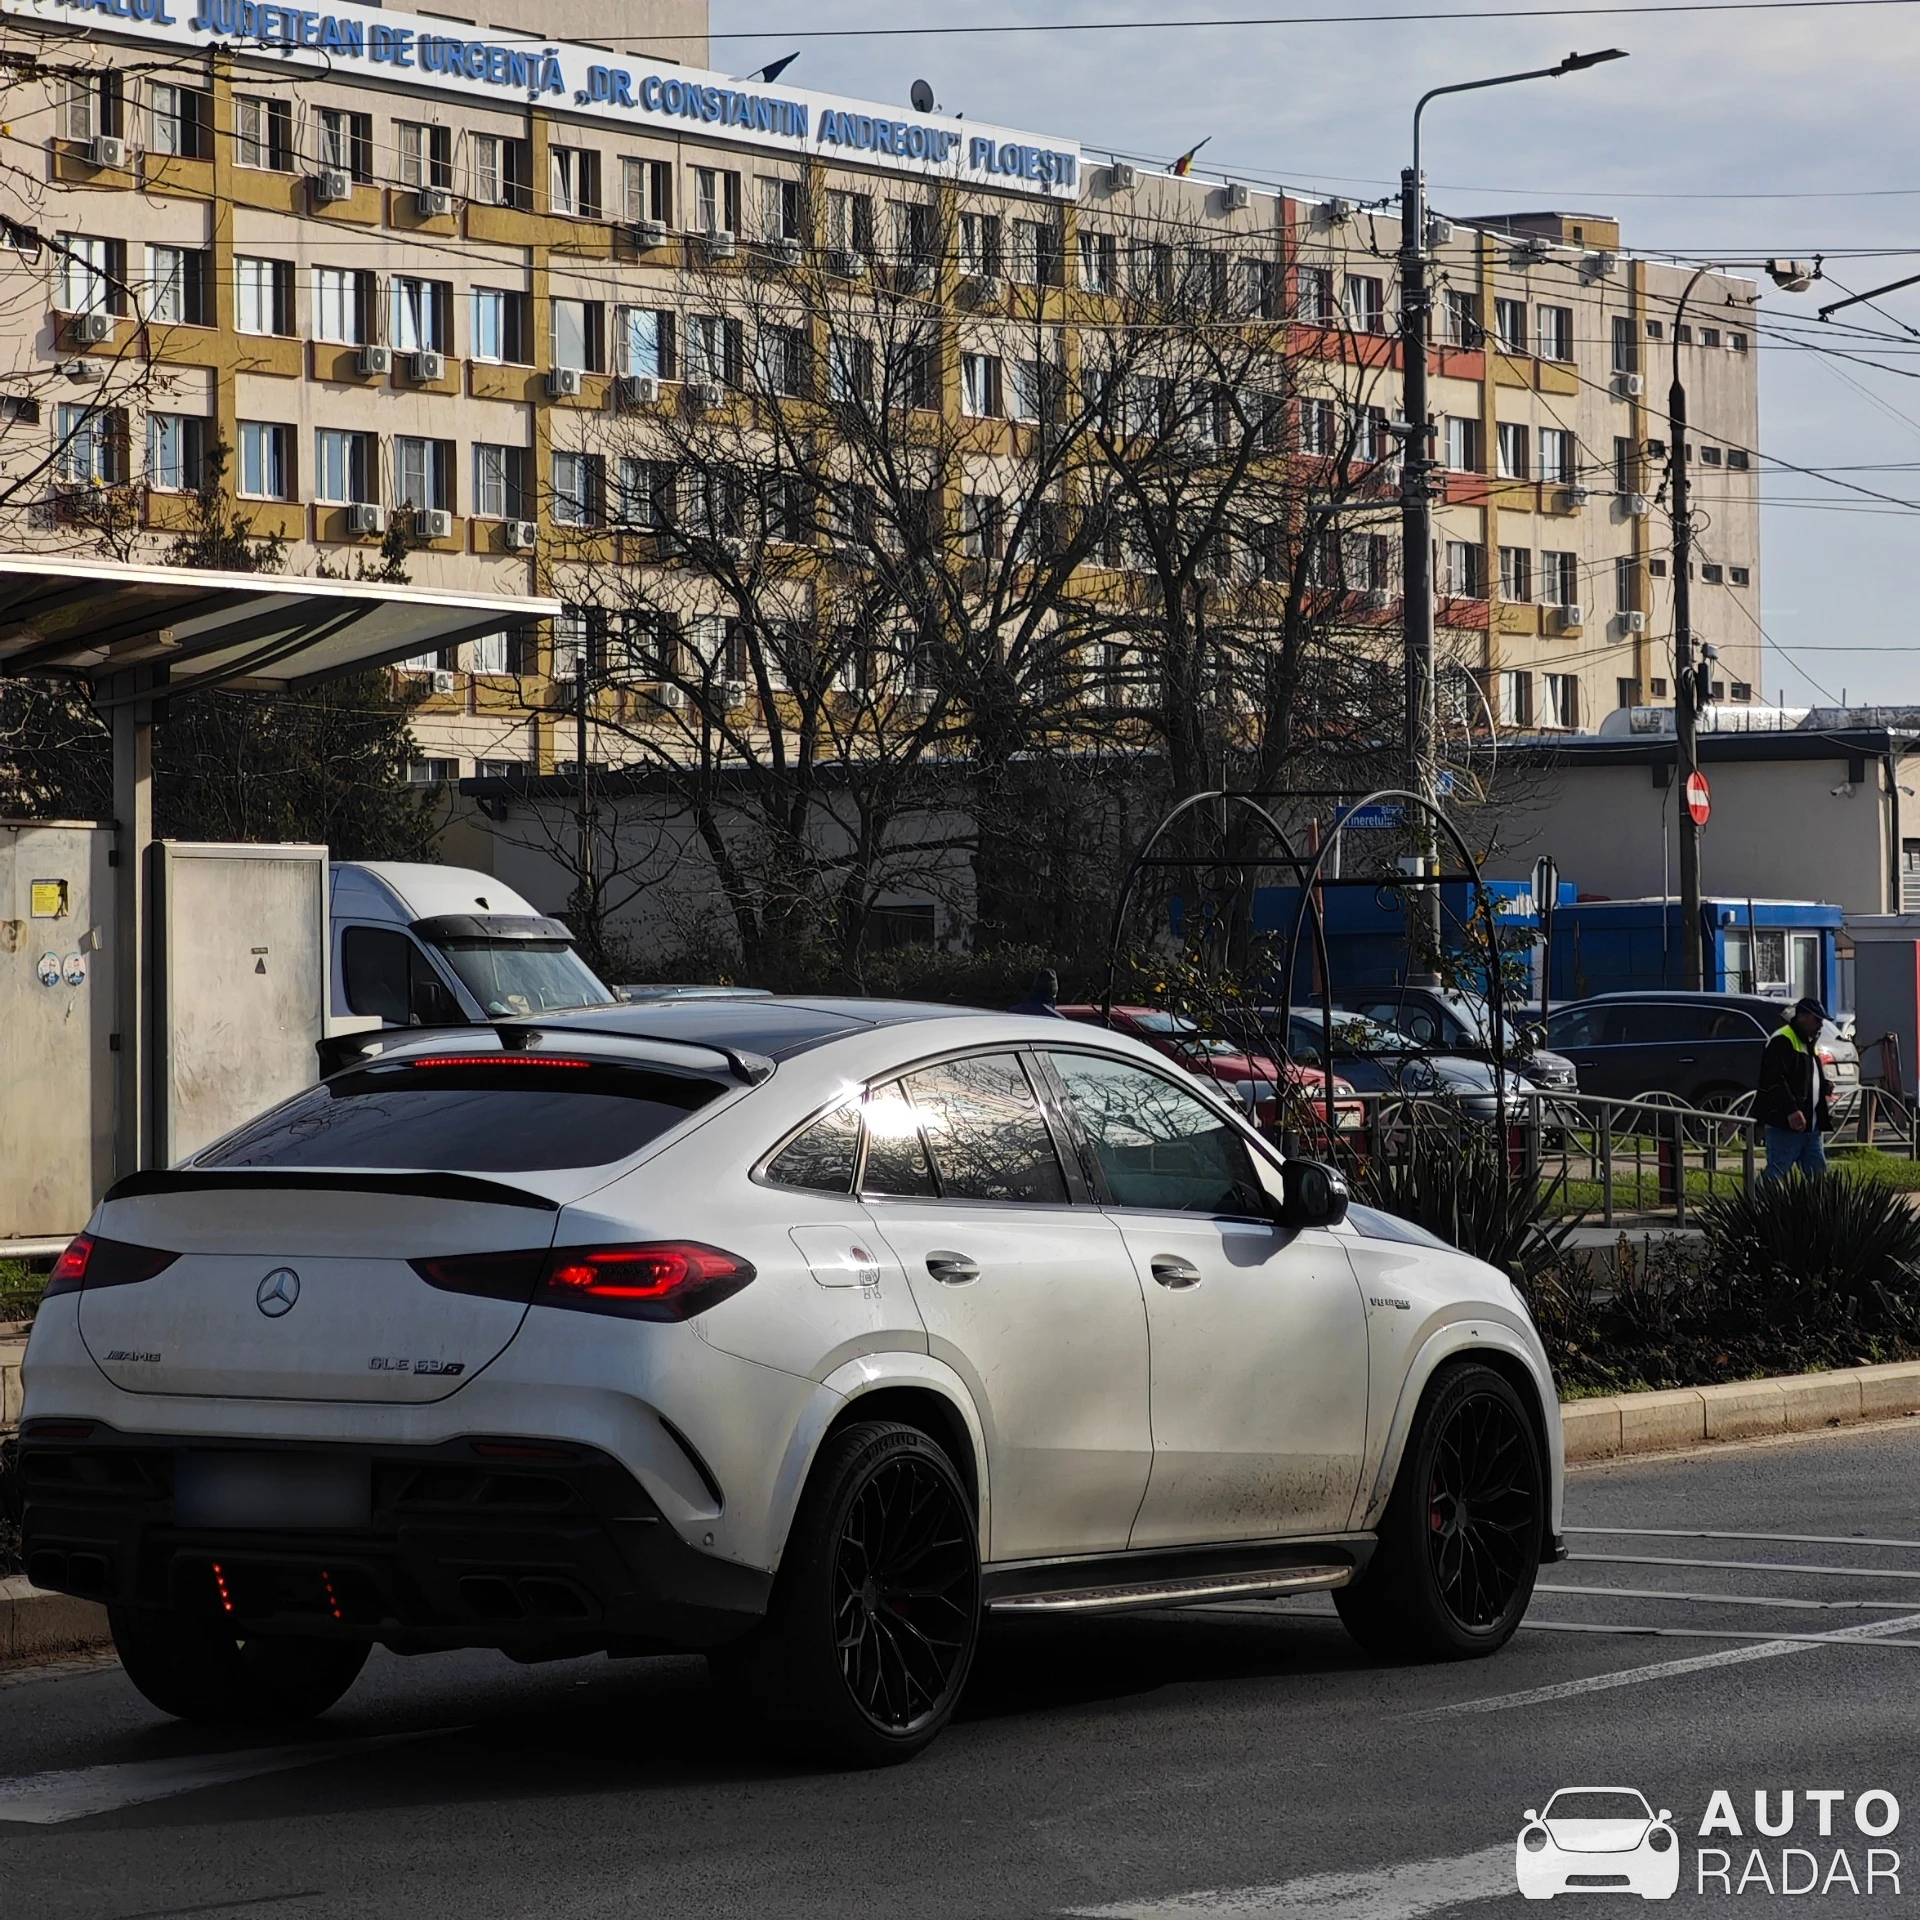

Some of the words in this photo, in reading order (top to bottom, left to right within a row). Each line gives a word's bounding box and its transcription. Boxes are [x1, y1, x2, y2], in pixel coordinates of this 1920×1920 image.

[368, 24, 415, 67] DE
[418, 33, 565, 102] URGENȚĂ
[639, 76, 808, 138] CONSTANTIN
[969, 136, 1076, 192] PLOIEȘTI
[368, 1357, 410, 1371] GLE
